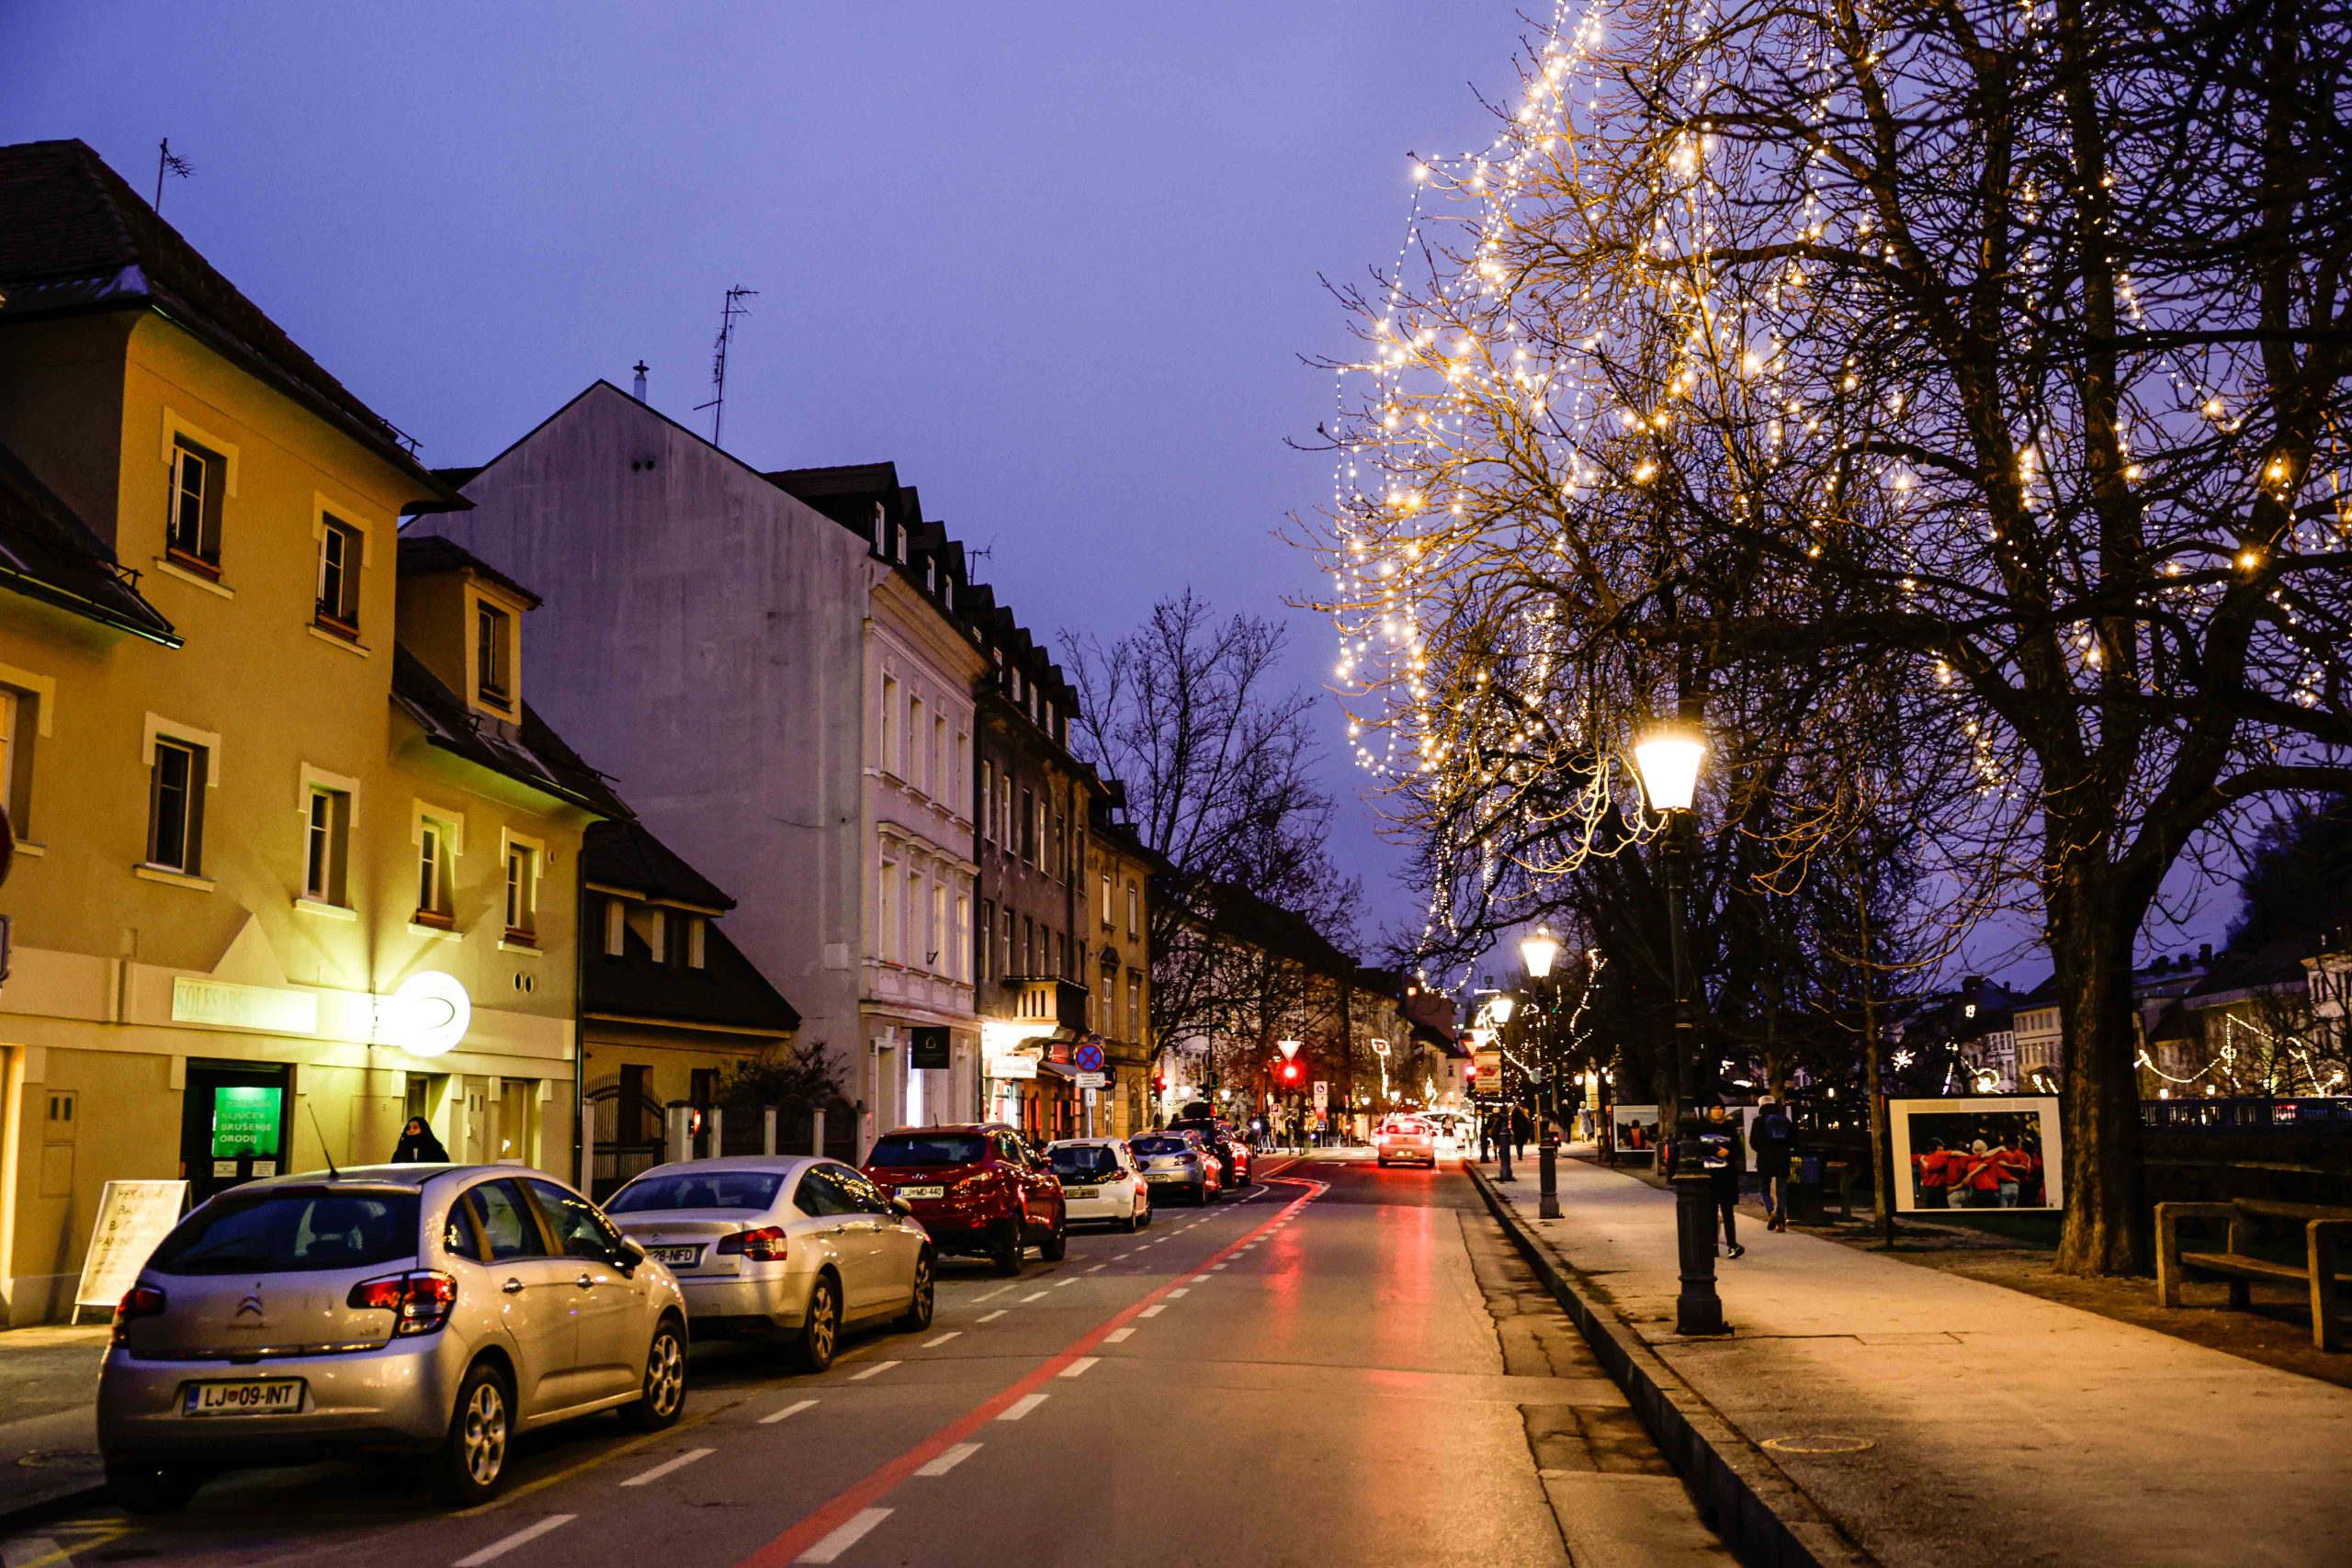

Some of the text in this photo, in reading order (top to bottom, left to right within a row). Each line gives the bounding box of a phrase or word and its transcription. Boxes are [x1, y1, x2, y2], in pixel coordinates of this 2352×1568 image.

[220, 1134, 257, 1144] ORODIJ
[205, 1385, 293, 1407] LJ 09-INT
